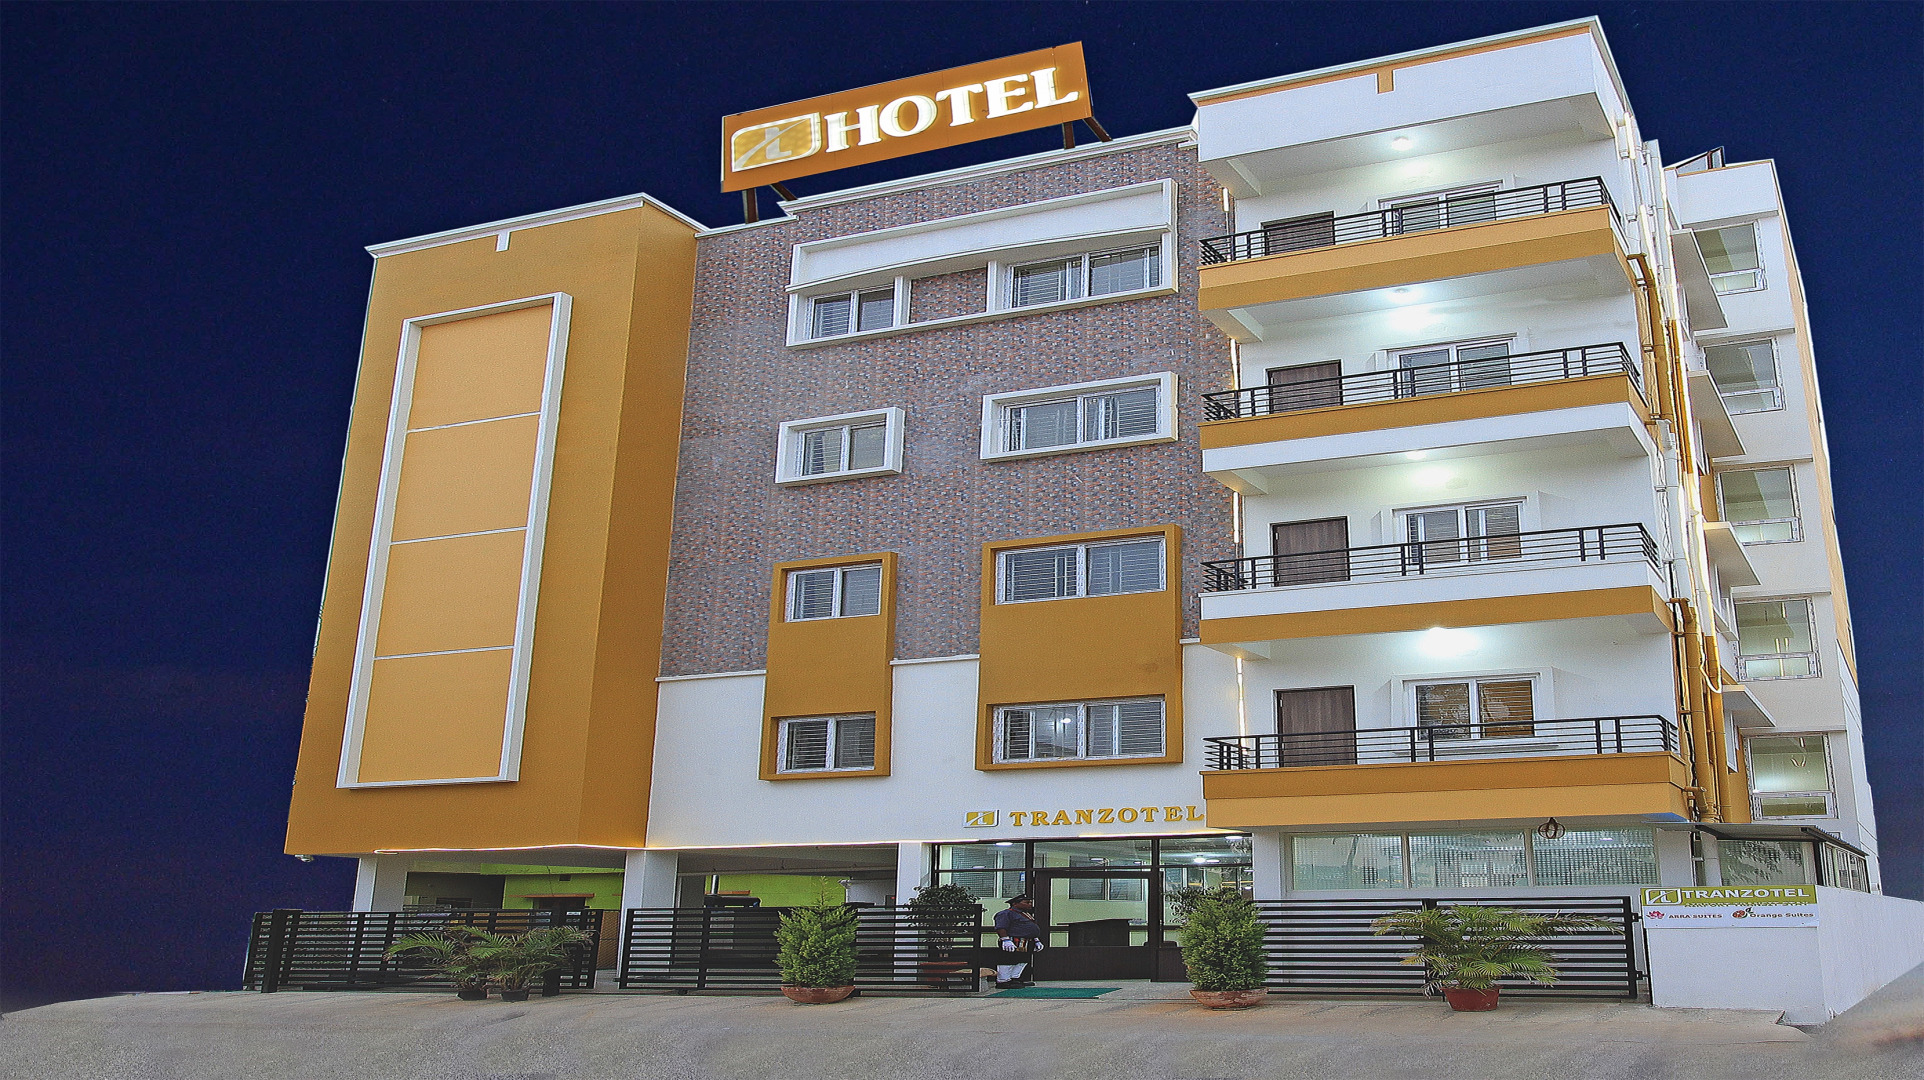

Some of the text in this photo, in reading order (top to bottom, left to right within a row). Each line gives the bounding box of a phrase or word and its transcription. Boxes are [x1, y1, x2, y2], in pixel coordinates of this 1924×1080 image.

[824, 67, 1079, 153] HOTEL
[1010, 805, 1205, 827] TRANZOTEL
[1682, 888, 1810, 899] TRANZOTEL
